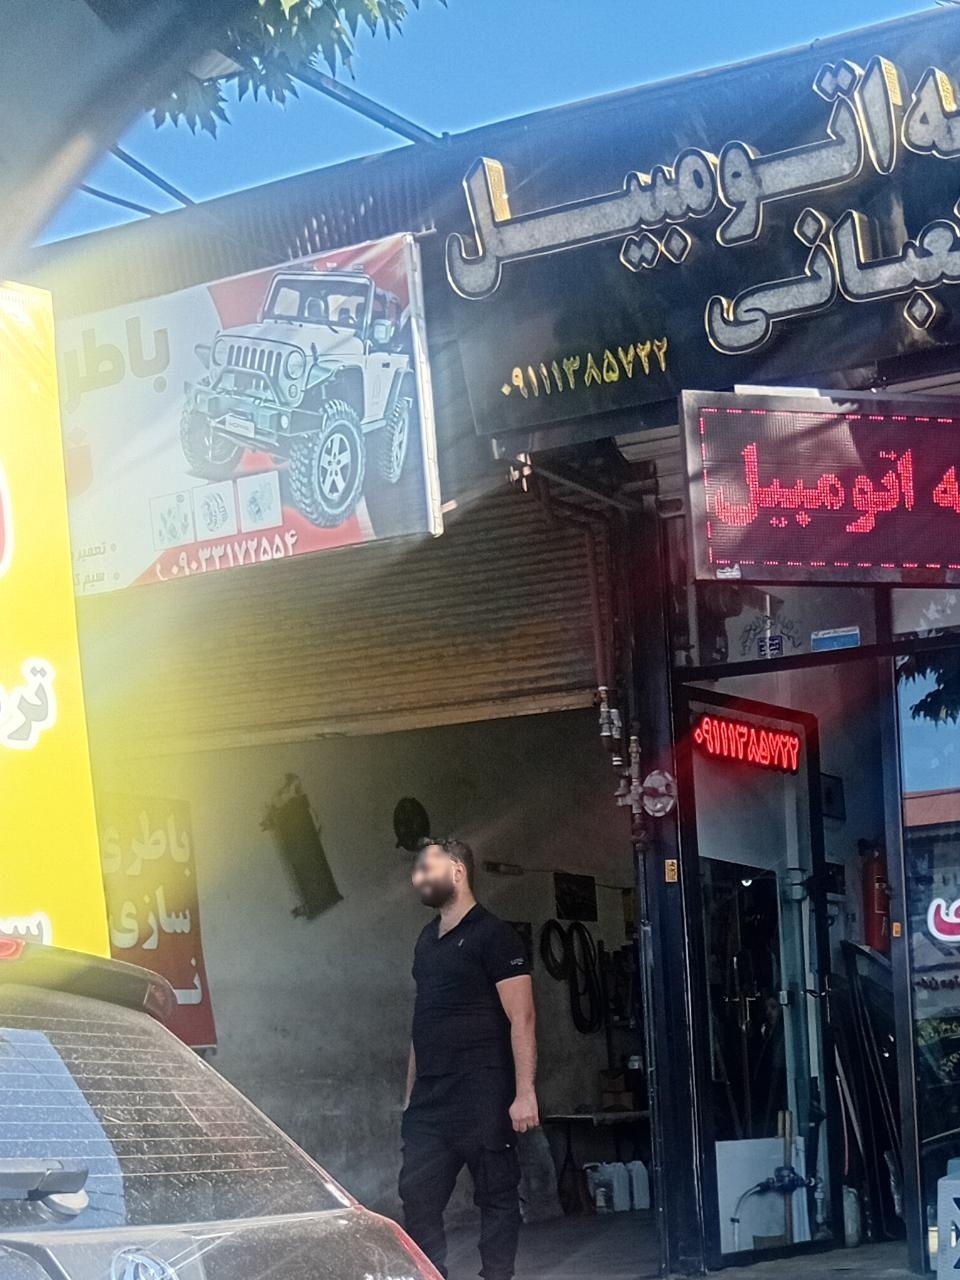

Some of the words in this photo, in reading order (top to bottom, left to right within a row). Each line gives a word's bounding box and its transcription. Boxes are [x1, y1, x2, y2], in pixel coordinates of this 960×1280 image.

[445, 55, 902, 300] اتومبیل
[500, 336, 668, 399] ۰۹۱۱۱۳۸۵۷۲۲
[714, 441, 915, 535] اتومبیل
[0, 664, 50, 744] تر
[693, 716, 800, 771] ۰۹۱۱۱۳۸۵۷۲۲
[110, 885, 191, 950] سازی
